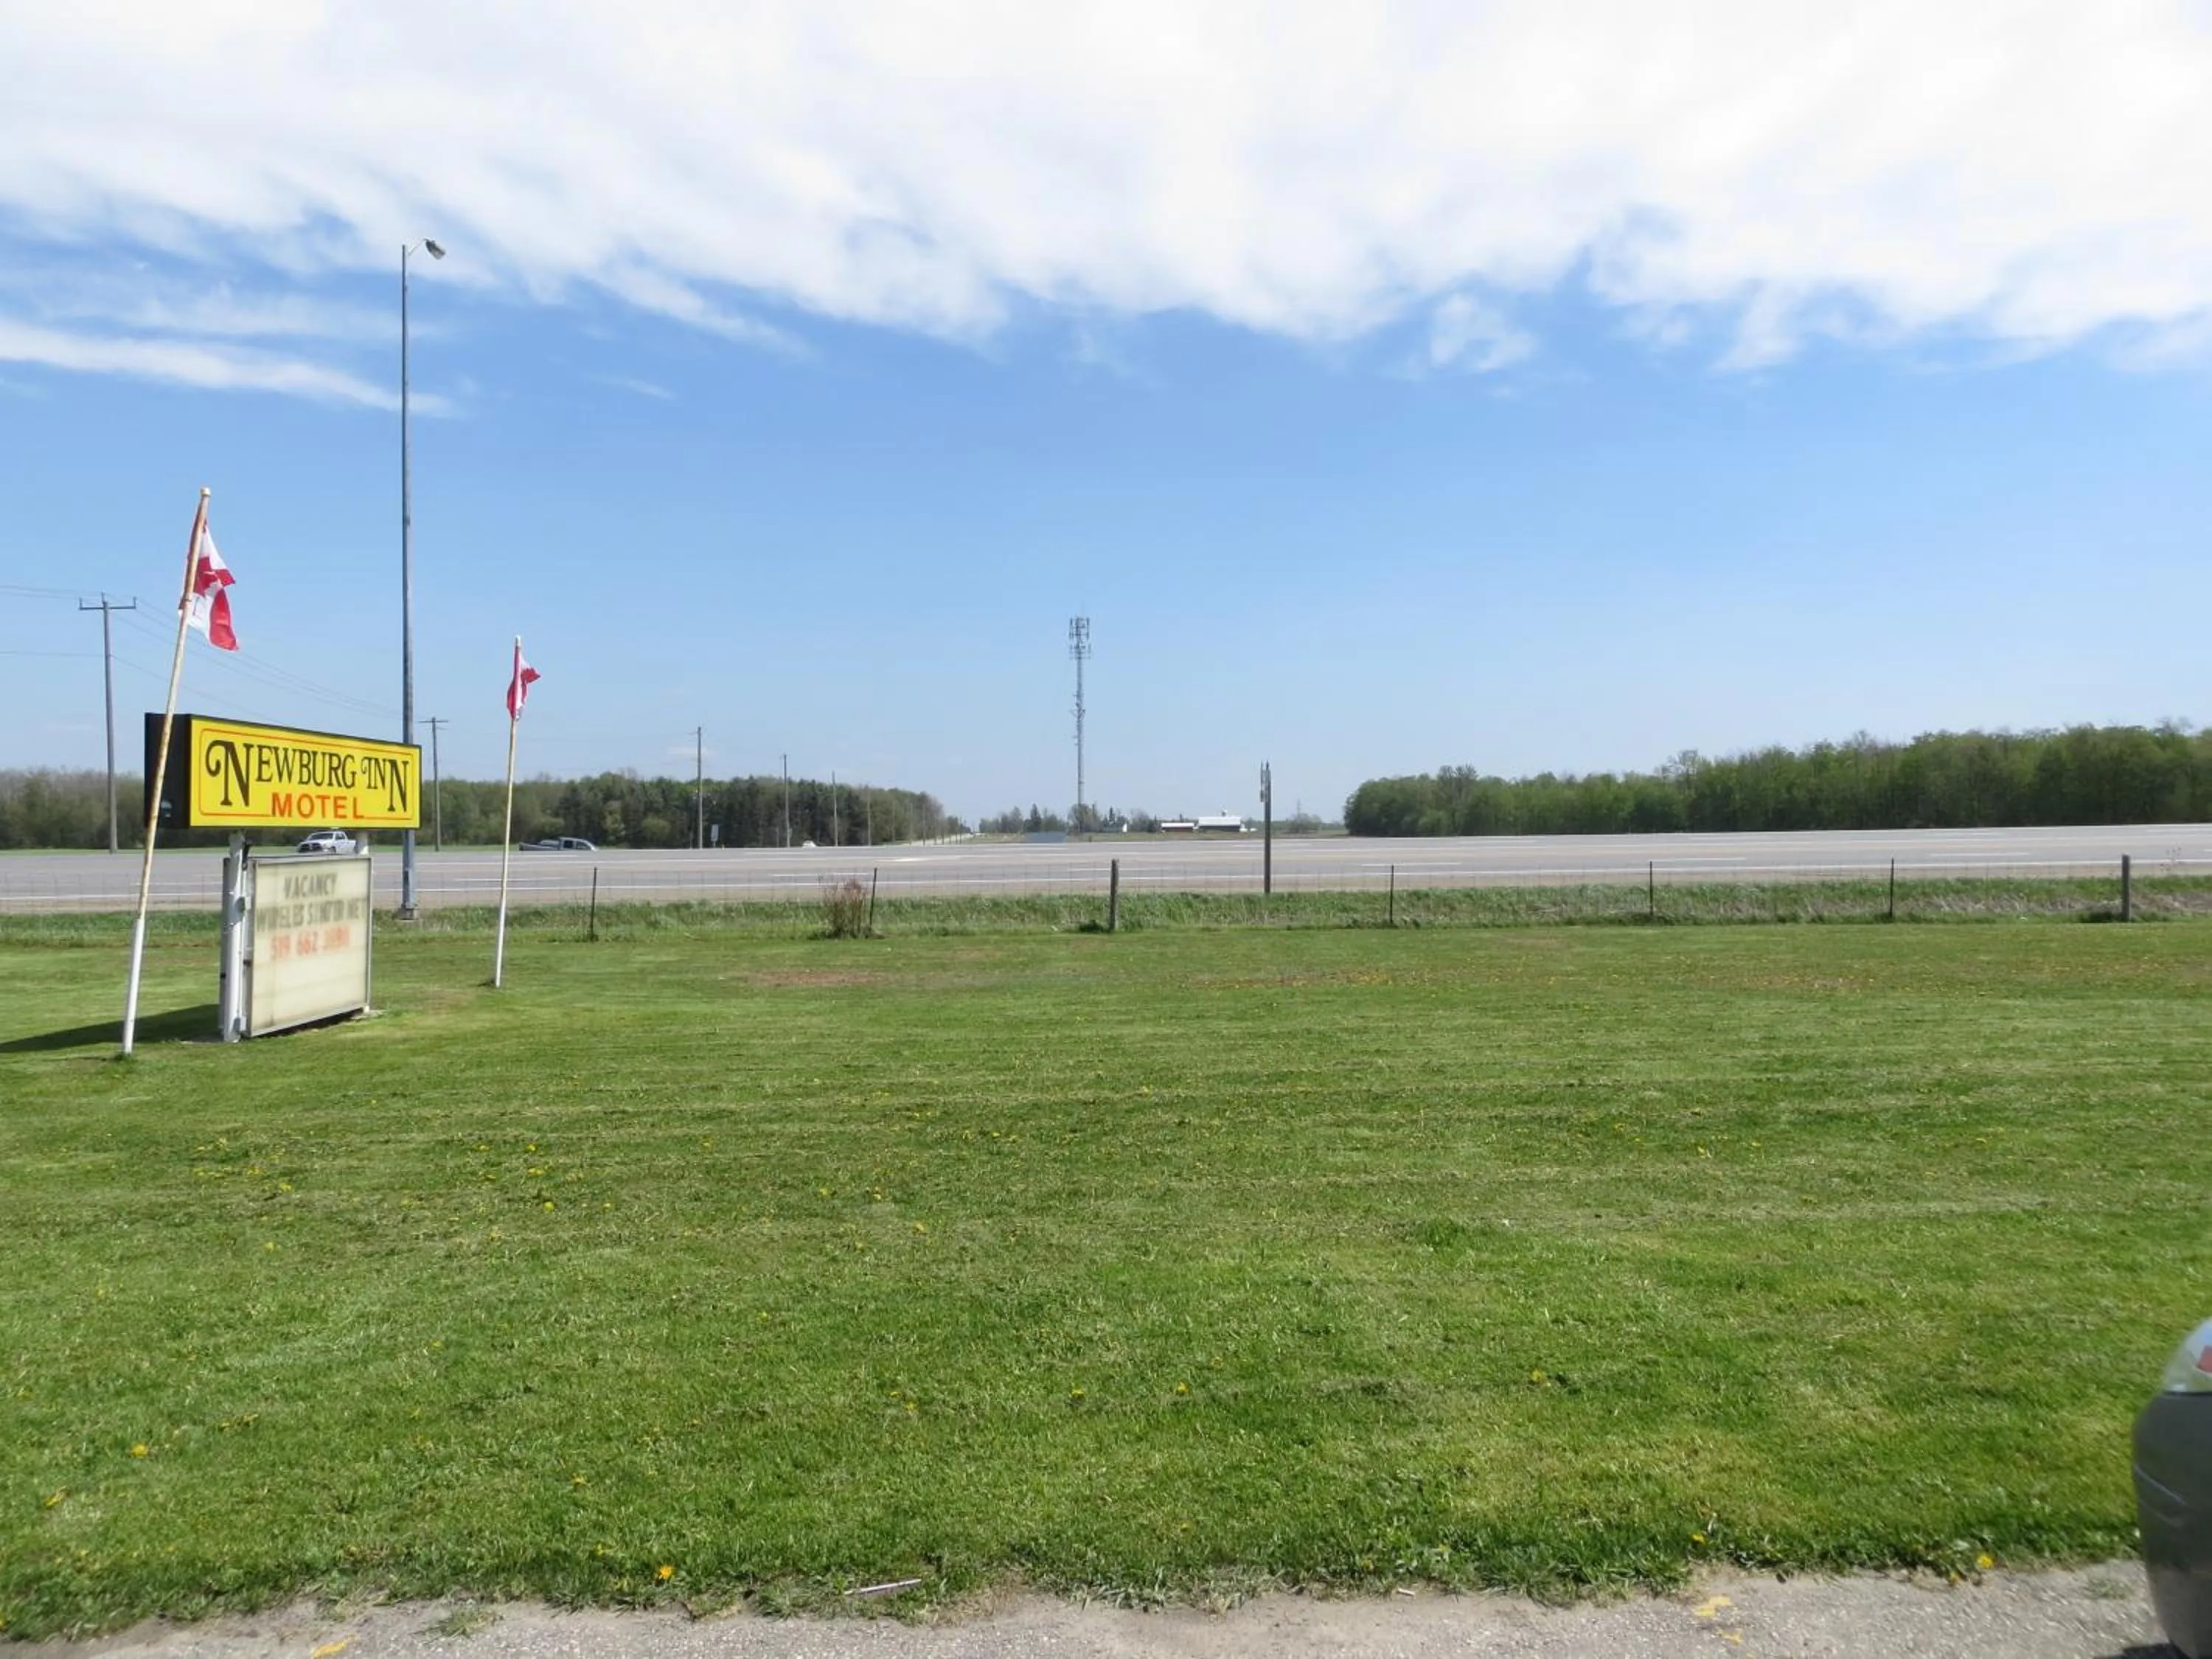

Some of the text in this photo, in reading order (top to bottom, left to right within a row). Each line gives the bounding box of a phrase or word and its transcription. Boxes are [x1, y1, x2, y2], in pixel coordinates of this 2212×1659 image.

[206, 740, 409, 813] NEWBURG INN
[271, 792, 364, 820] MOTEL
[284, 872, 338, 900] VACANCY
